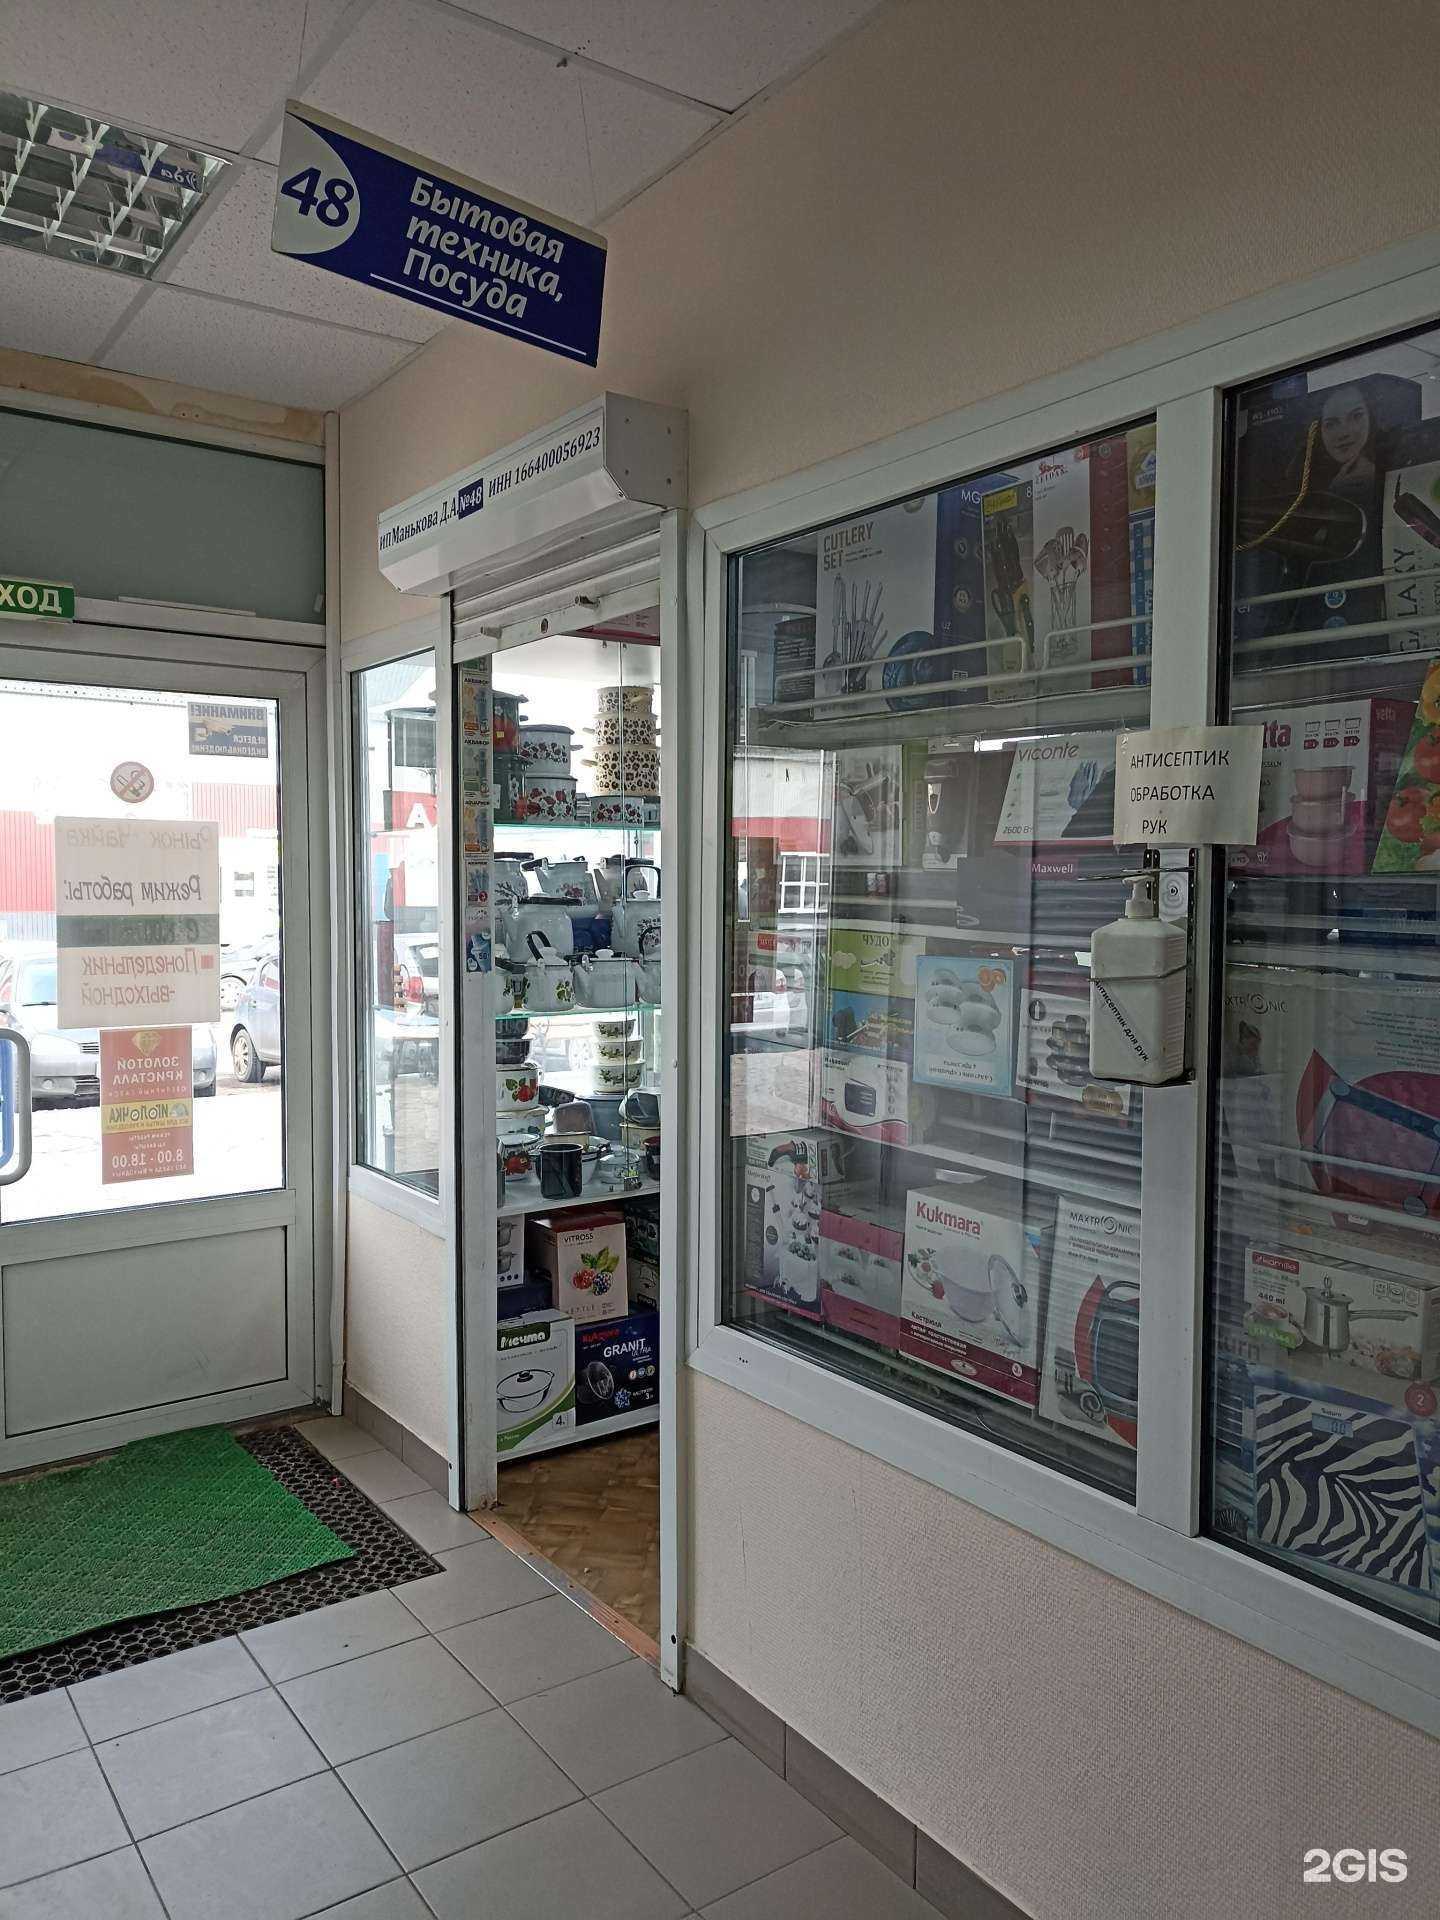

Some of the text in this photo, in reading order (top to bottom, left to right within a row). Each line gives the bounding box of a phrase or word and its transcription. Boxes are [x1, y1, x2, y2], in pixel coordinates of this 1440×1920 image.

[281, 166, 355, 228] 48
[409, 176, 564, 263] Бытовая
[406, 217, 564, 303] техника,
[402, 249, 528, 319] Посуда
[458, 484, 483, 512] №48
[488, 471, 512, 498] ИНН
[514, 426, 600, 486] 166400056923
[823, 521, 875, 553] CUTLERY
[823, 550, 845, 571] SET
[1018, 742, 1080, 763] viconte
[1130, 748, 1230, 770] АНТИСЕПТИК
[1130, 784, 1215, 803] ОБРАБОТКА
[1141, 818, 1168, 836] РУК
[1031, 863, 1073, 874] Maxwell
[862, 934, 890, 948] ЧУДО
[1094, 979, 1150, 1063] Антисептик для рук
[916, 1200, 982, 1236] Kukmara
[563, 1232, 594, 1244] VITROSS
[603, 1337, 647, 1358] GRANIT
